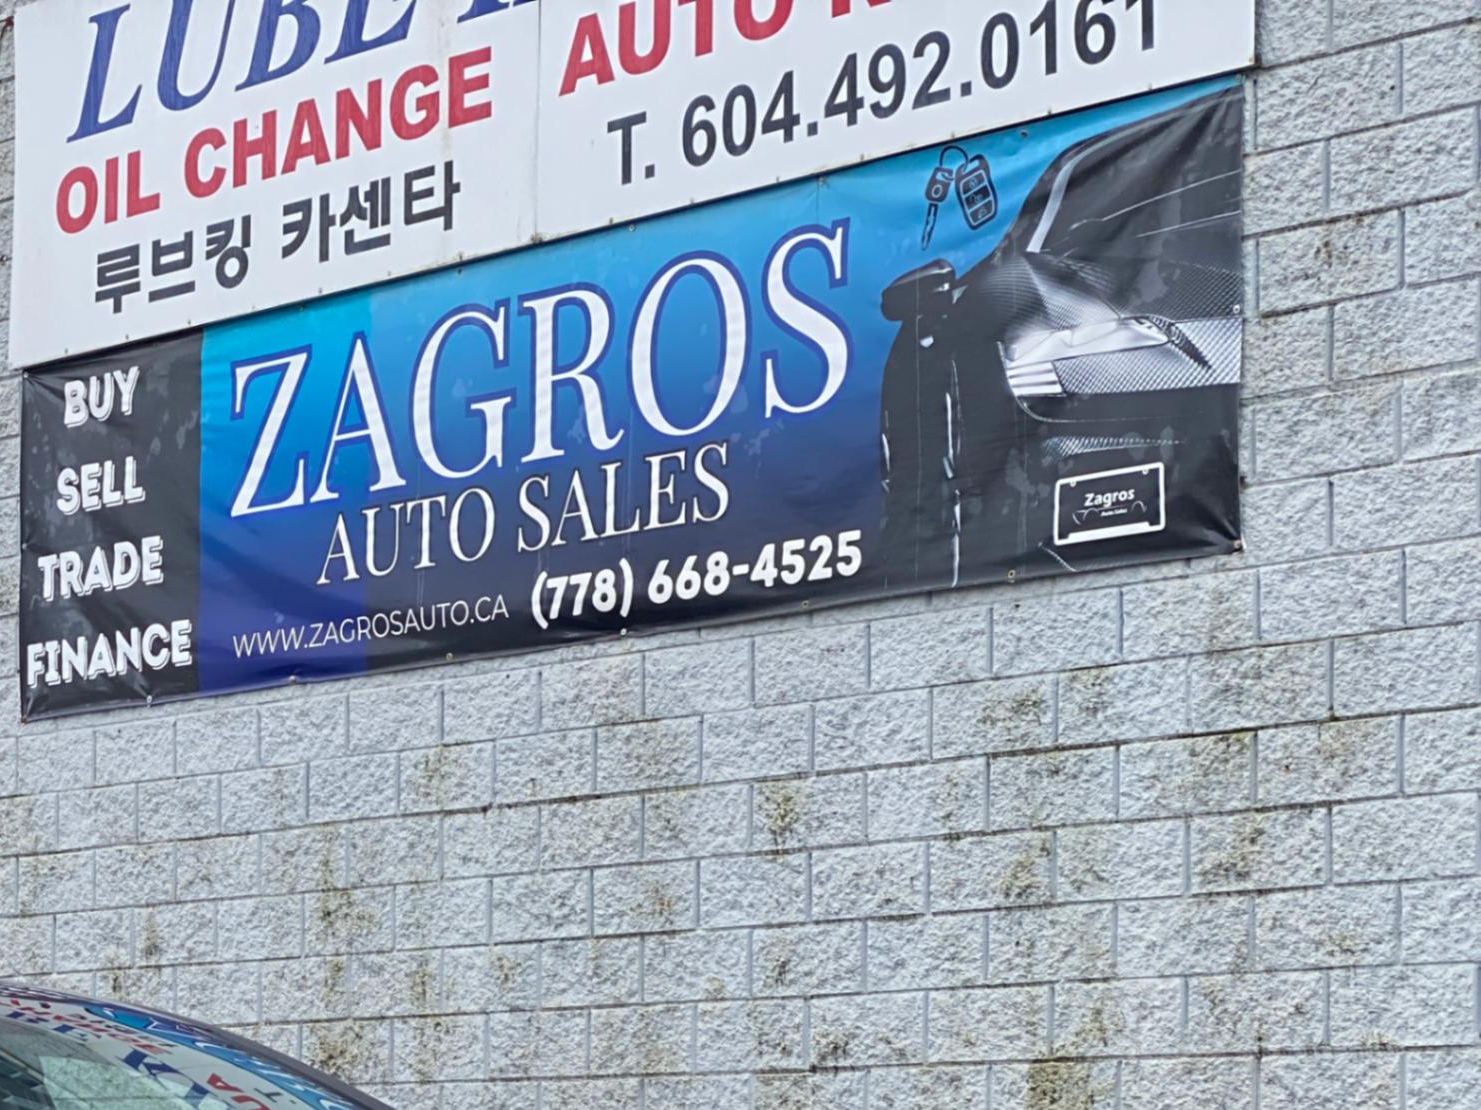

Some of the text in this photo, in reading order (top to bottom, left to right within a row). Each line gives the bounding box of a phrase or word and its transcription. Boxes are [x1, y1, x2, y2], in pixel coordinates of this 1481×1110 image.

[607, 0, 1154, 185] T. 604.492.0161
[55, 46, 493, 234] OIL CHANGE
[95, 160, 461, 314] 루브킹 카센타
[63, 366, 140, 427] BUY
[229, 222, 851, 519] ZAGROS
[56, 456, 146, 516] SELL
[316, 441, 730, 585] AUTO SALES
[1084, 488, 1135, 508] Zagros
[38, 535, 164, 602] TRADE
[531, 529, 862, 630] (778) 668-4525
[27, 619, 193, 688] FINANCE
[232, 594, 510, 659] WWW.ZAGROSAUTO.CA
